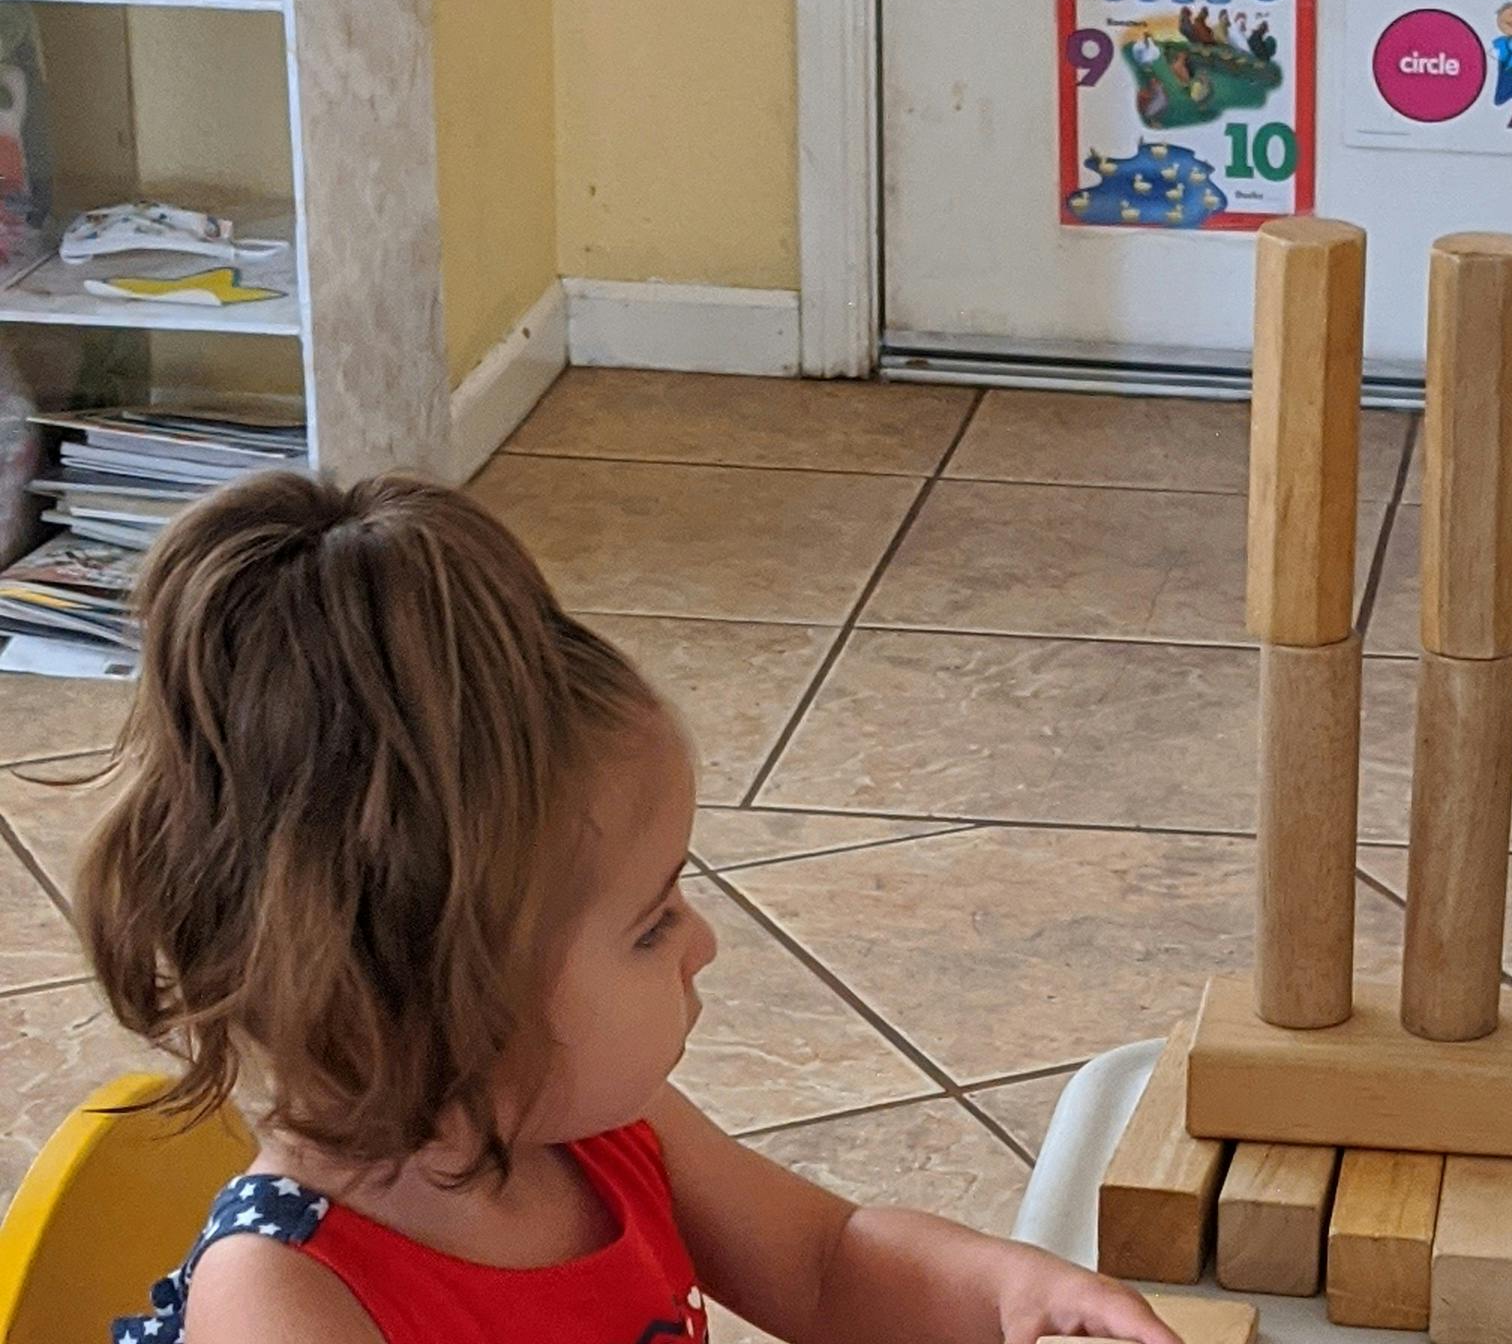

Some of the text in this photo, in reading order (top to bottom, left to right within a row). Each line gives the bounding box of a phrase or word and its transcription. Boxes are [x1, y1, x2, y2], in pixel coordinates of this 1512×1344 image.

[1067, 29, 1114, 87] 9
[1399, 53, 1460, 77] circle
[1224, 122, 1299, 182] 10
